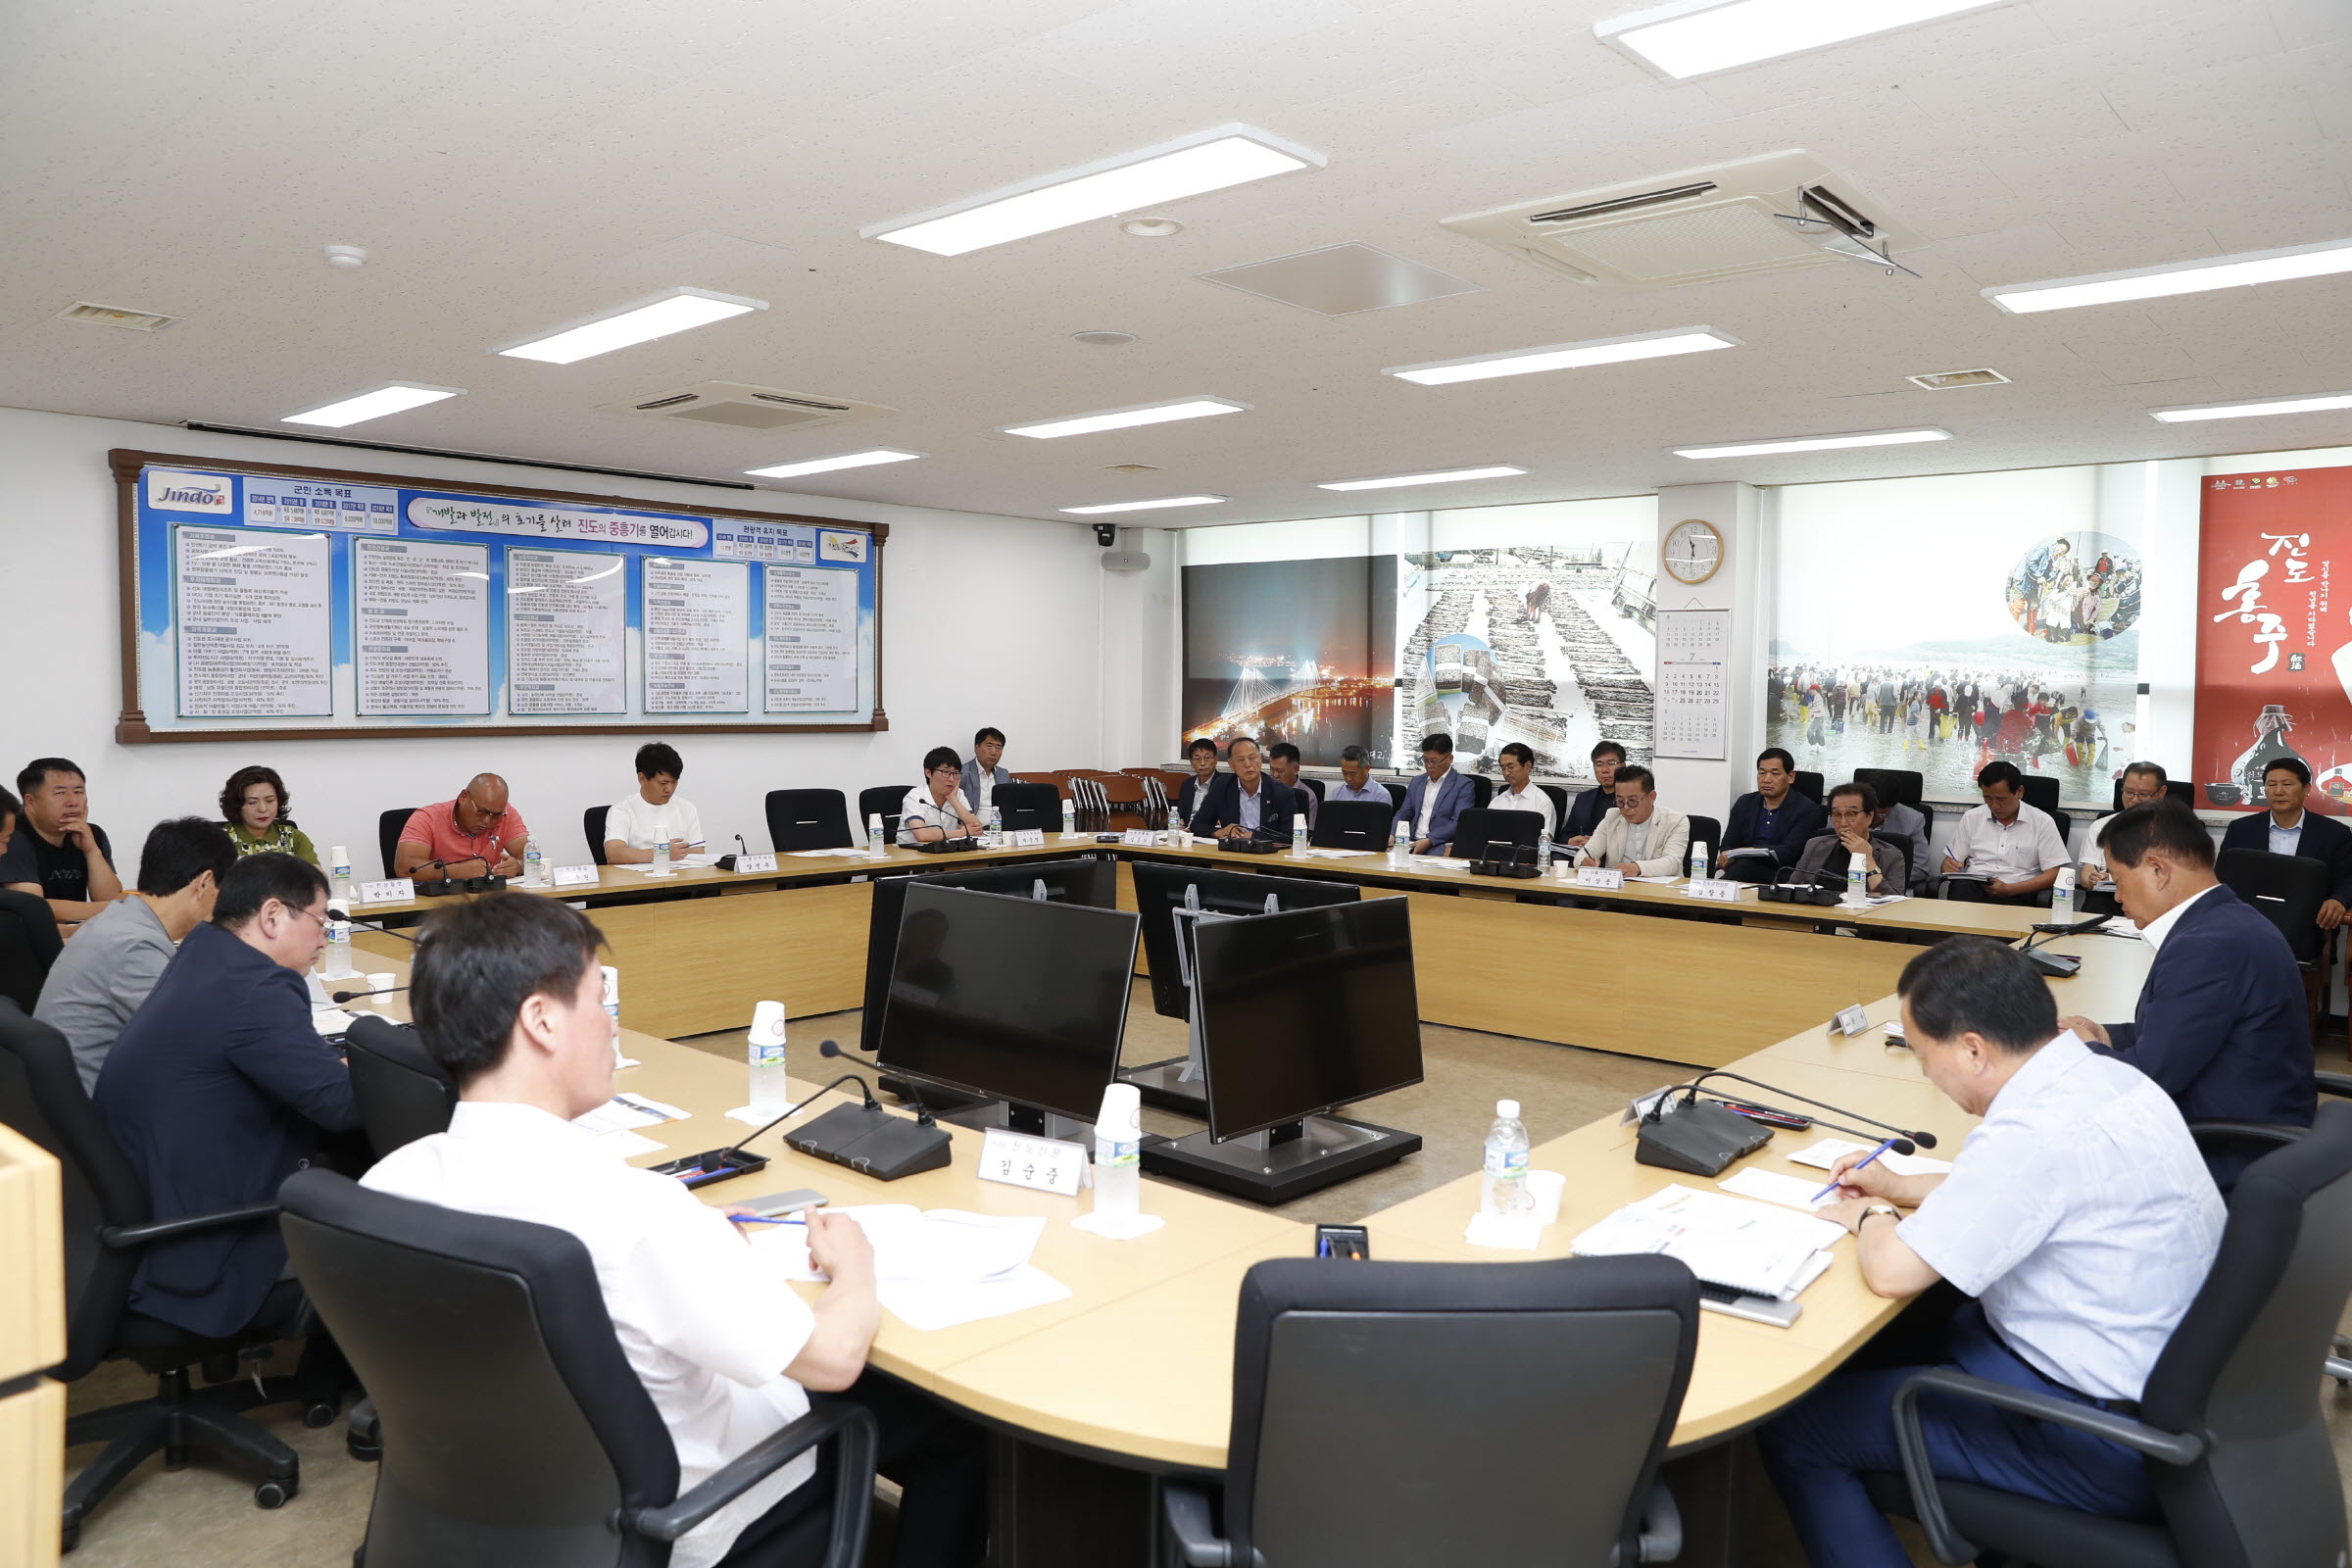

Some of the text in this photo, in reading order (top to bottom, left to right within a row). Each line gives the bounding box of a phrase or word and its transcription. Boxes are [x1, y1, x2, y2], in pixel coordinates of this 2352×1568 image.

[158, 487, 214, 506] Jindo
[294, 486, 352, 498] 군민 소득 목표
[550, 516, 572, 530] 살려
[577, 518, 607, 535] 진도의
[609, 520, 647, 538] 중흥기를
[649, 524, 693, 540] 열어갑시다!
[743, 526, 761, 535] 관광객
[1712, 546, 1717, 554] 3
[2261, 532, 2315, 583] 진도
[2213, 559, 2289, 675] 홍주
[1690, 652, 1695, 661] 7
